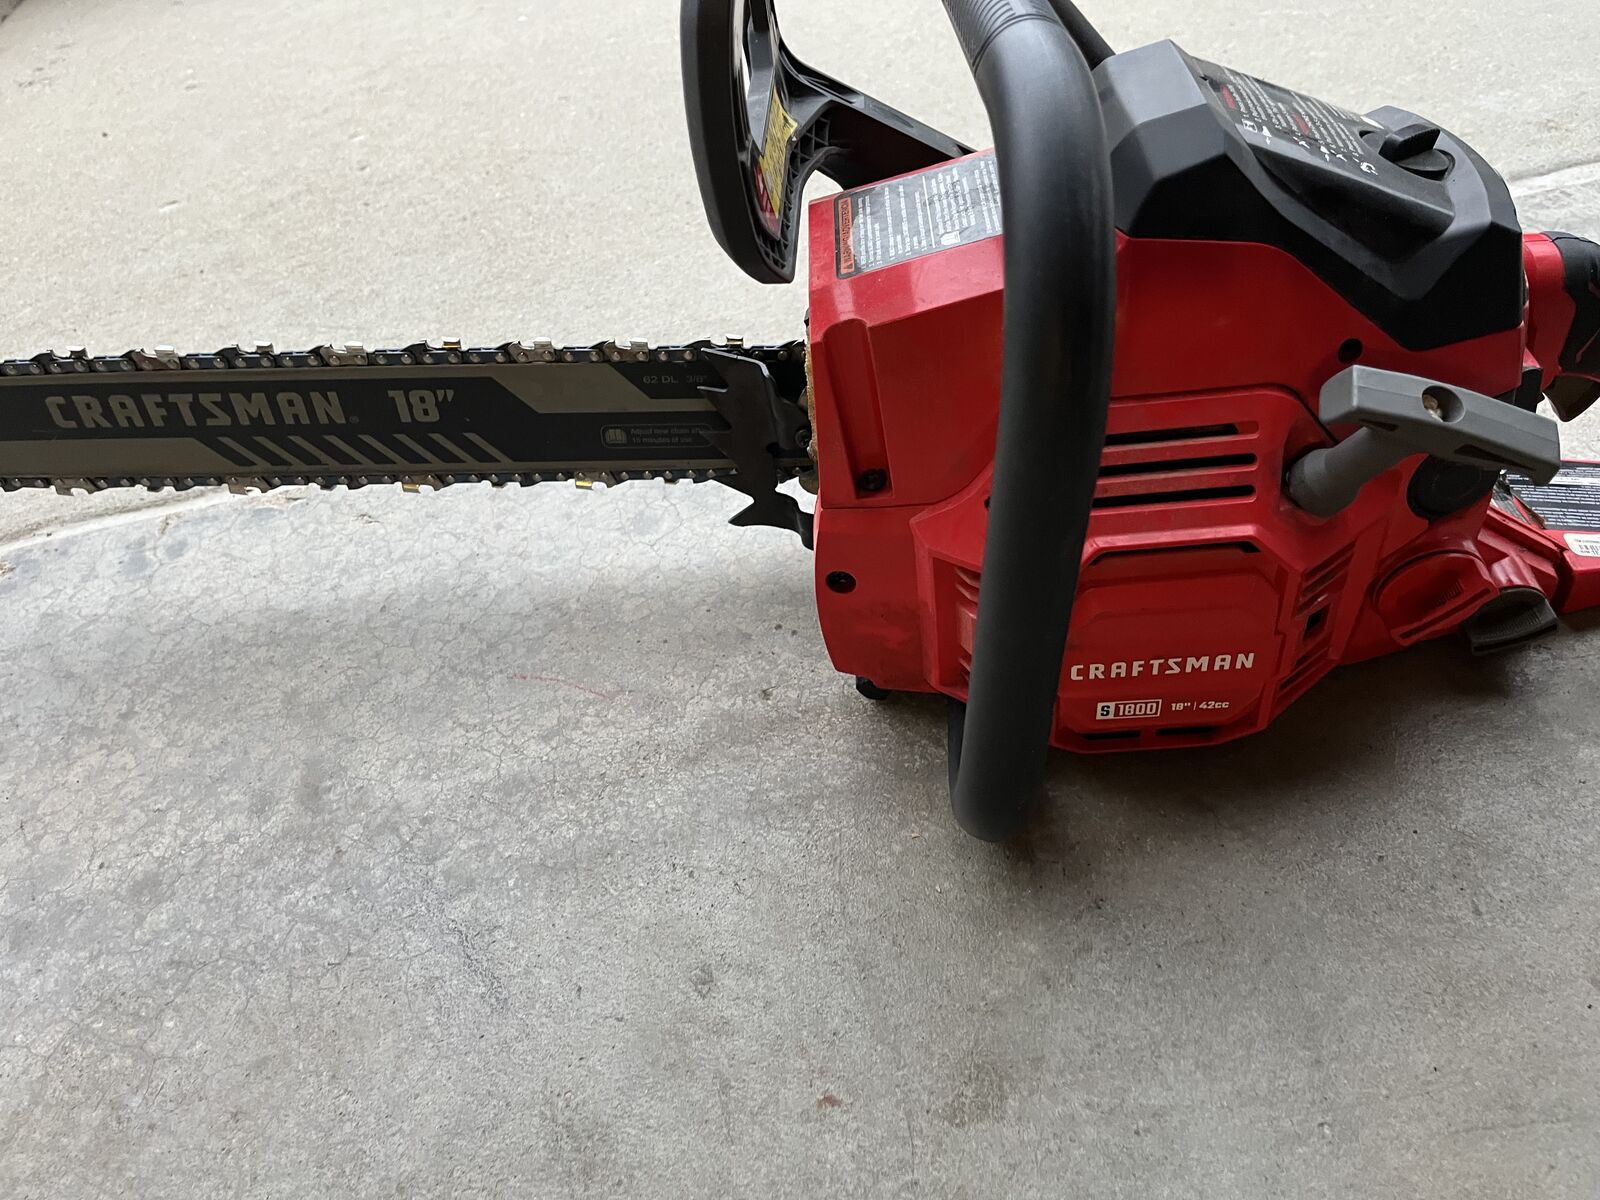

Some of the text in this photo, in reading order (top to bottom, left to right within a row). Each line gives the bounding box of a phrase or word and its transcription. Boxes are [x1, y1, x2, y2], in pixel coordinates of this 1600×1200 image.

[45, 389, 455, 430] CRAFTSMAN 18"
[1070, 652, 1255, 681] CRAFTSMAN
[1199, 700, 1229, 710] 42cc
